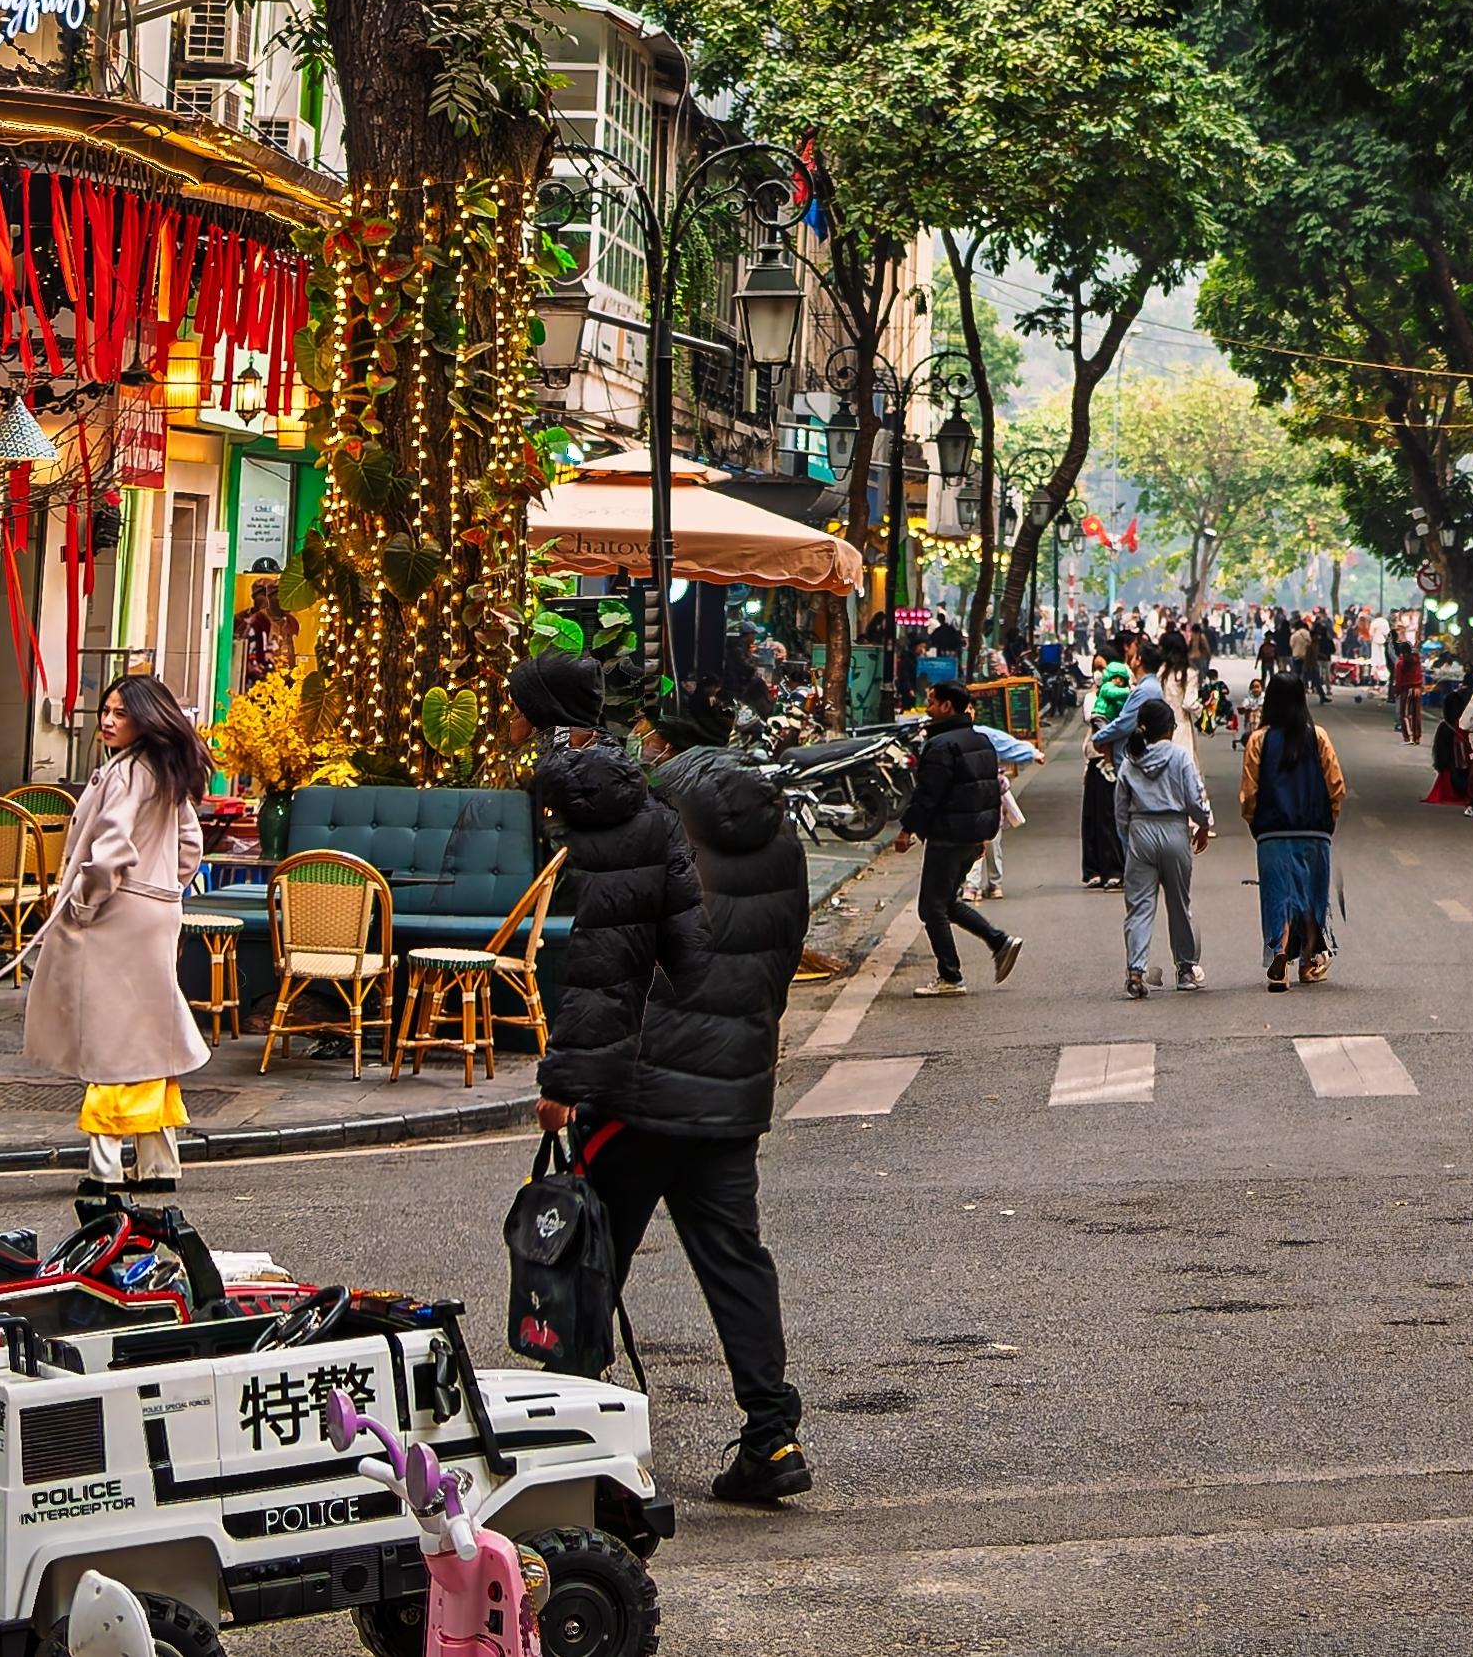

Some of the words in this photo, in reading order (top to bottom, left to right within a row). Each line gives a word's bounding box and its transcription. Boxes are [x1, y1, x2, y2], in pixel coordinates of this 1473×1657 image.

[143, 1404, 163, 1414] POLICE
[165, 1401, 186, 1412] SPECIAL
[187, 1398, 211, 1409] FORCES
[31, 1480, 123, 1509] POLICE
[19, 1496, 136, 1525] INTERCEPTOR
[265, 1496, 360, 1535] POLICE
